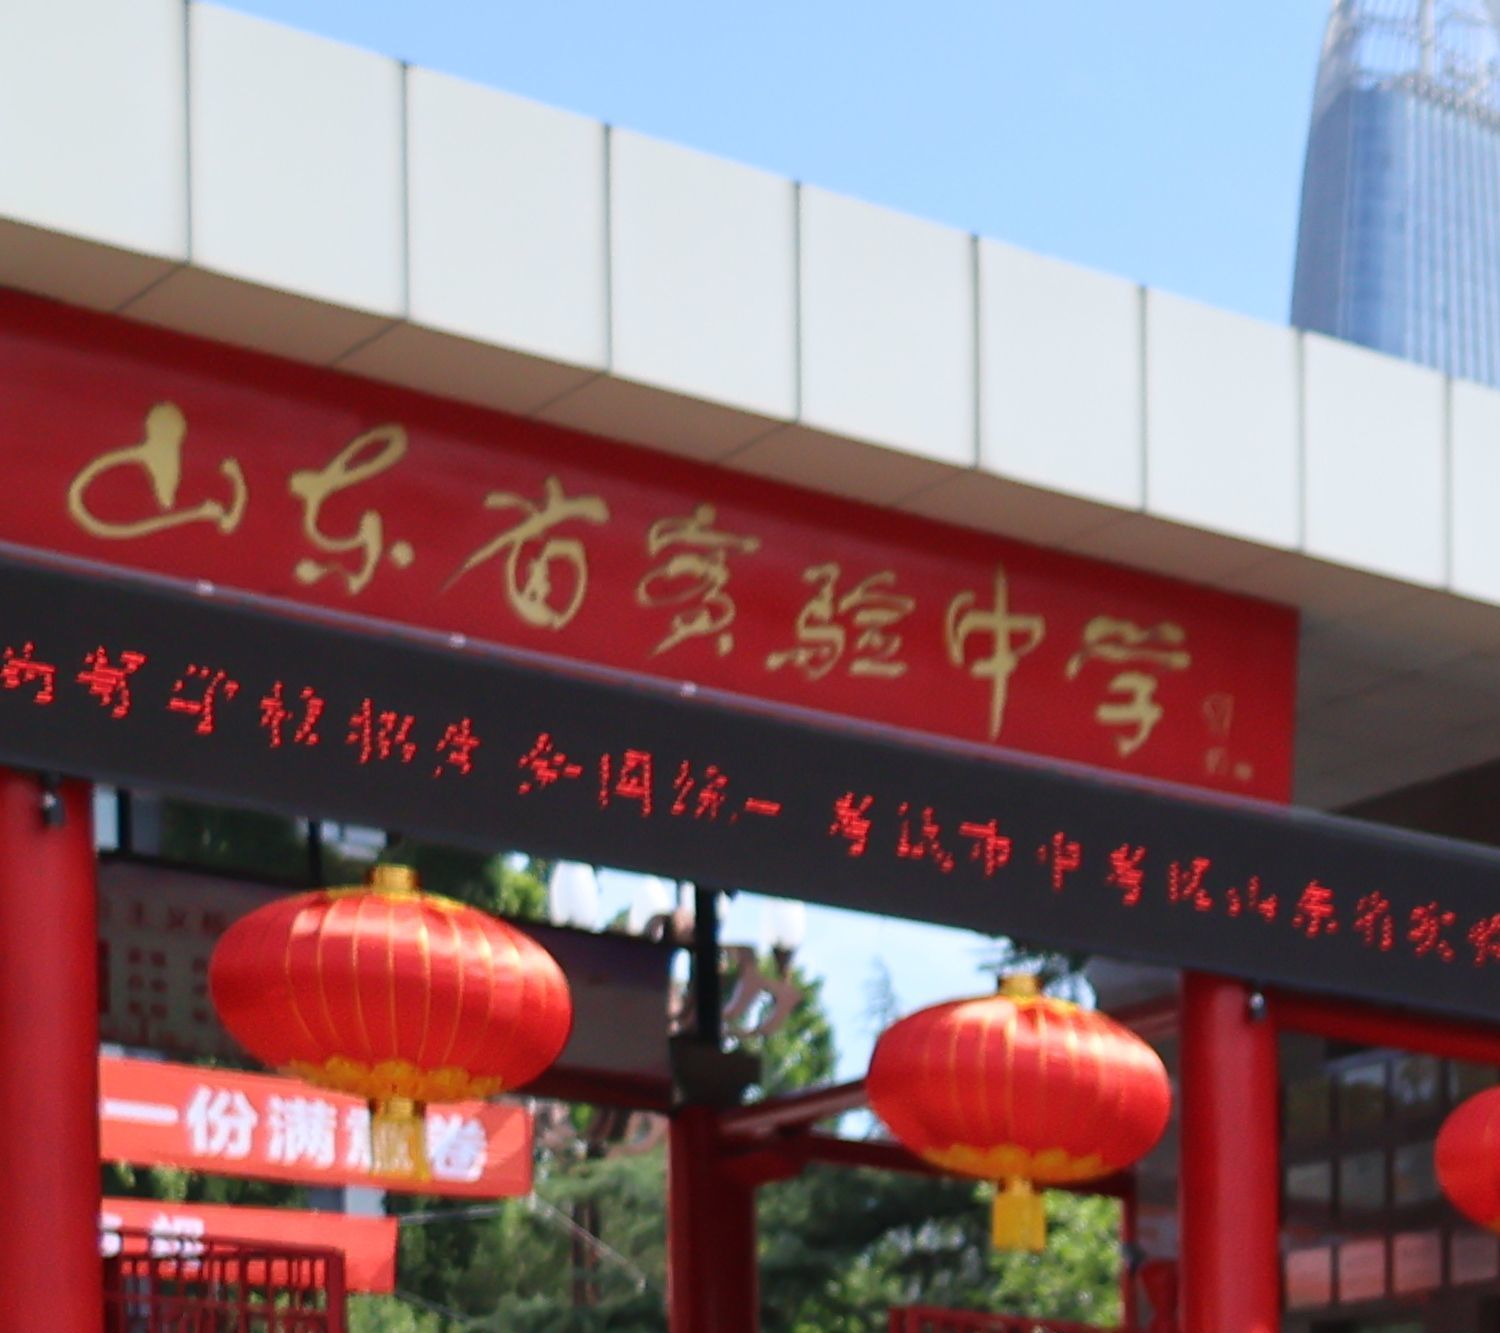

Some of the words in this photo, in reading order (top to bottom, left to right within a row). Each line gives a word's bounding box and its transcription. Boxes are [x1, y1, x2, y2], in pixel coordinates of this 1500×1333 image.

[68, 402, 1191, 757] 山东省实验中学
